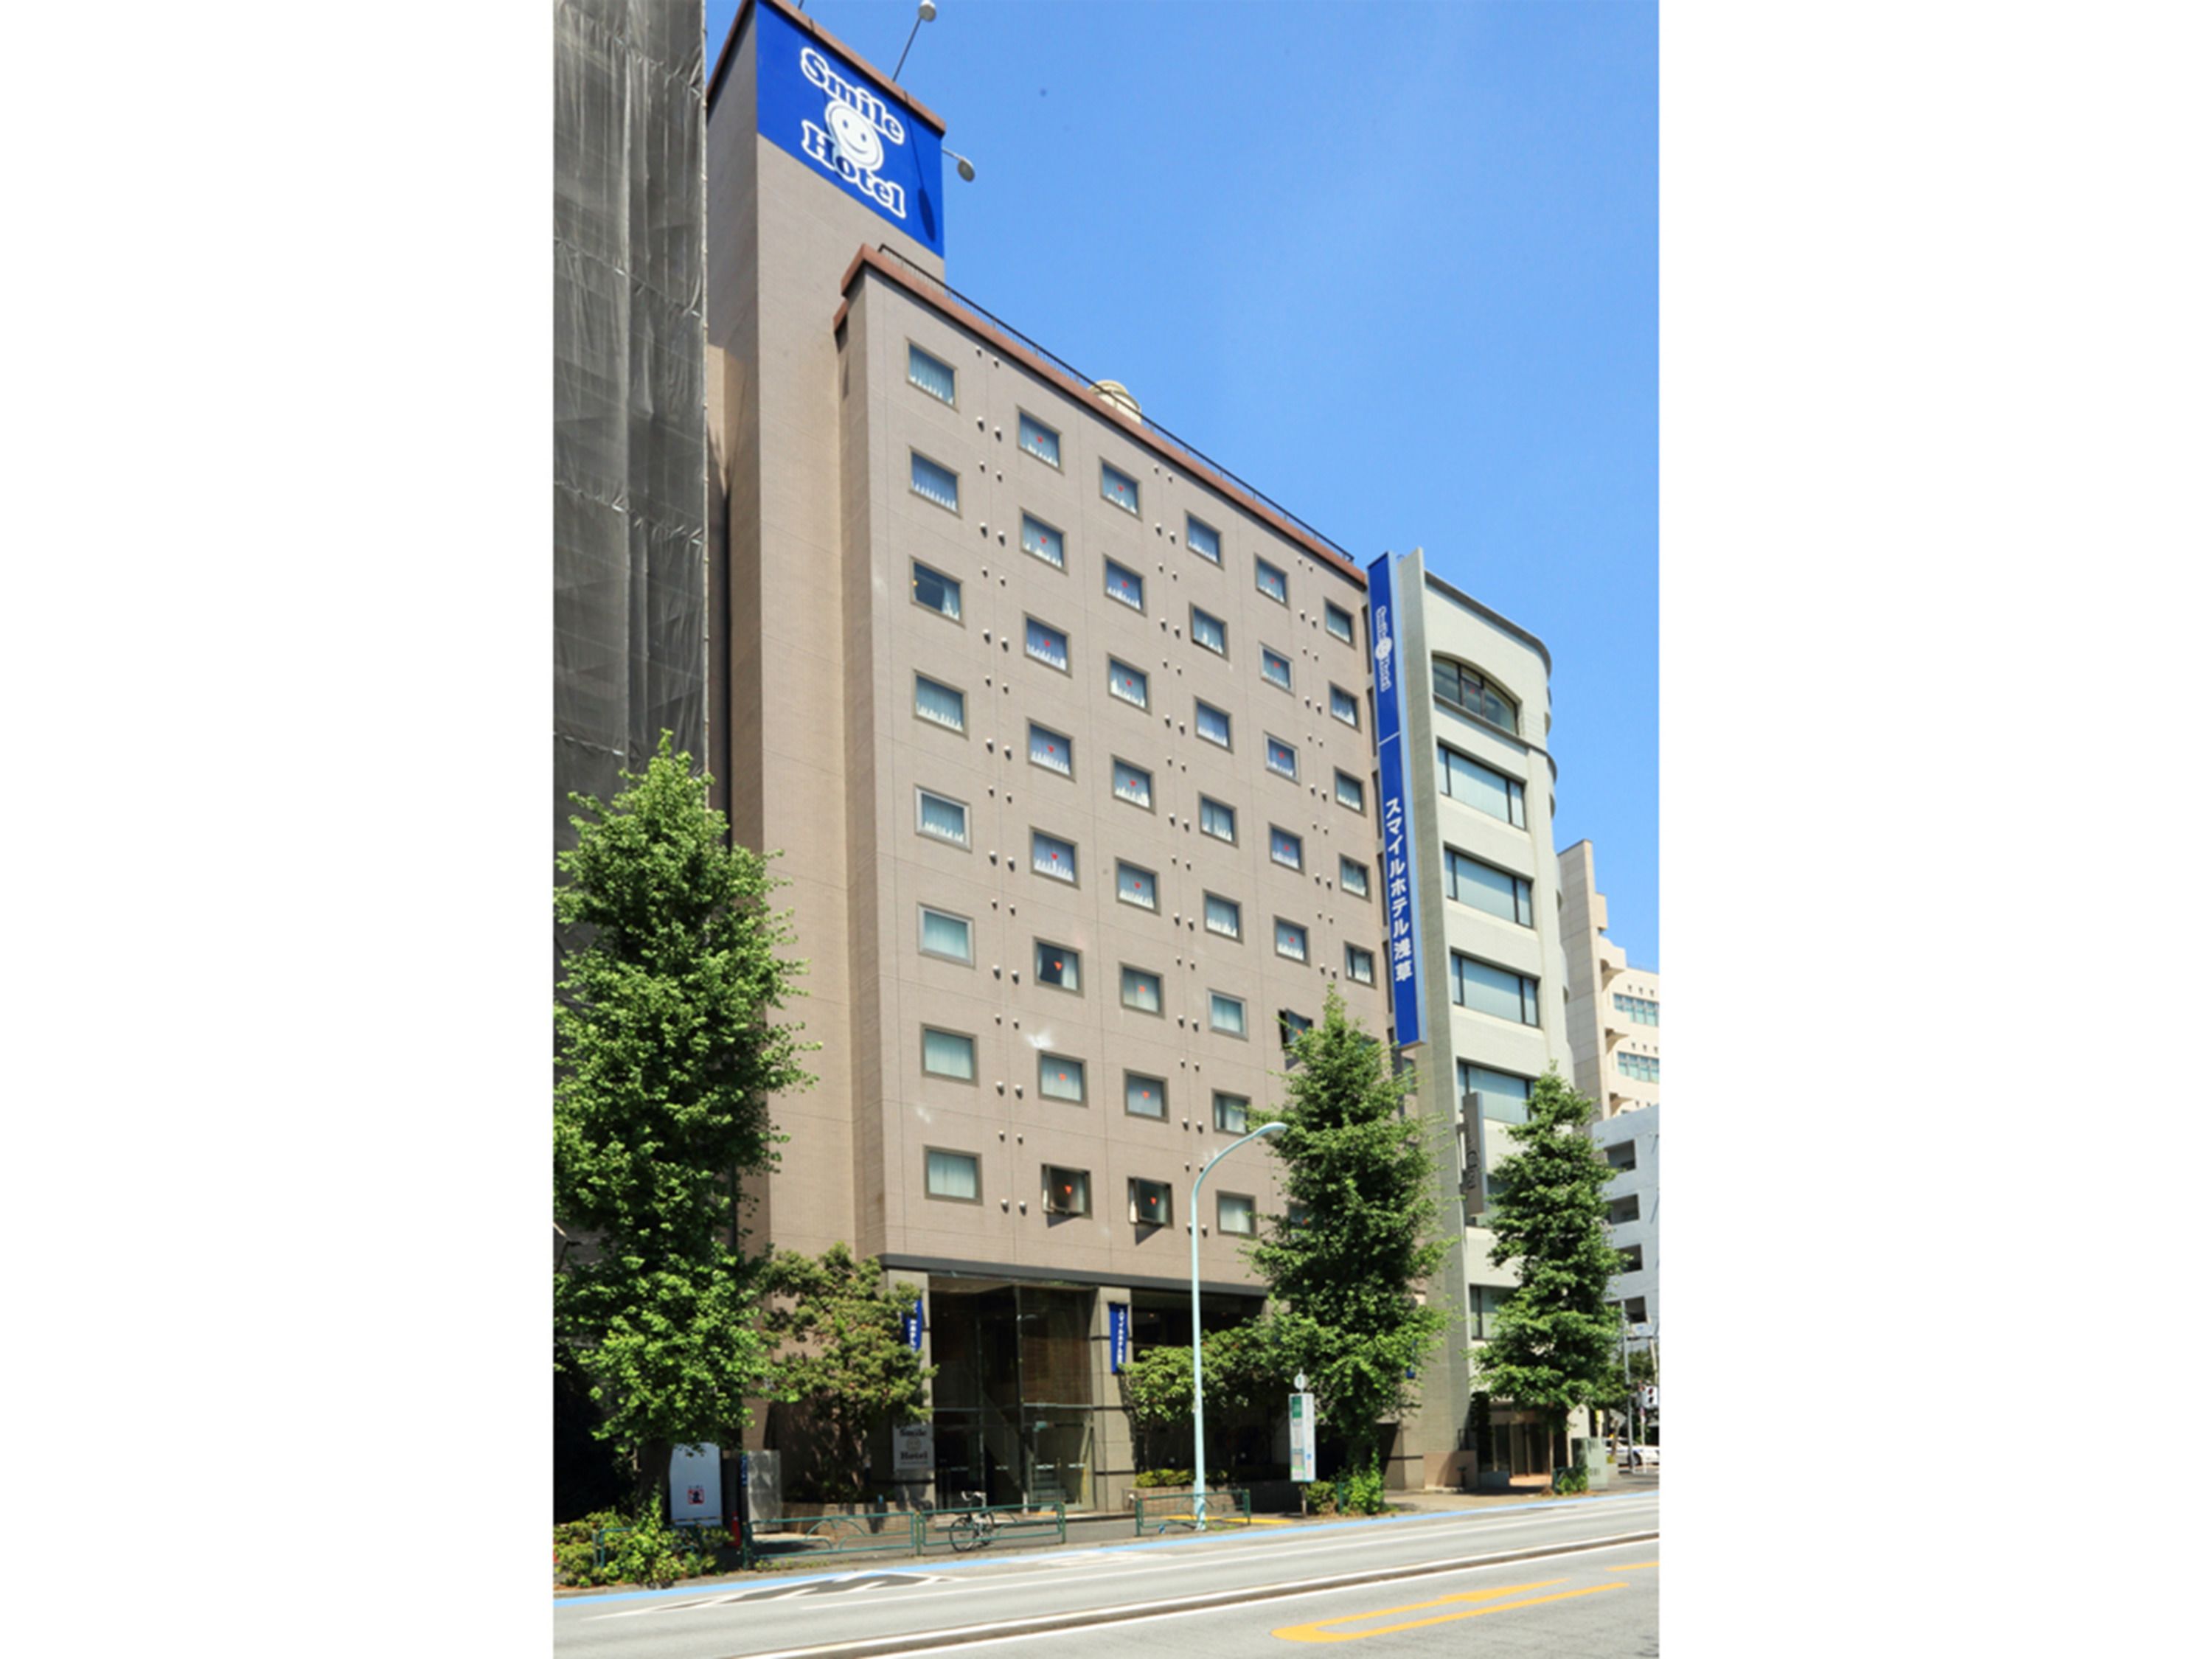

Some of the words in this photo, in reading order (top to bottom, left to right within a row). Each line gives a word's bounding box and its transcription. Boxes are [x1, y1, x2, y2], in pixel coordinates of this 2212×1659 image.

[801, 47, 905, 146] Smile
[801, 119, 906, 219] Hotel
[1386, 797, 1412, 982] スマイルホテル浅草
[900, 1427, 927, 1437] Smile
[900, 1451, 928, 1460] Hotel
